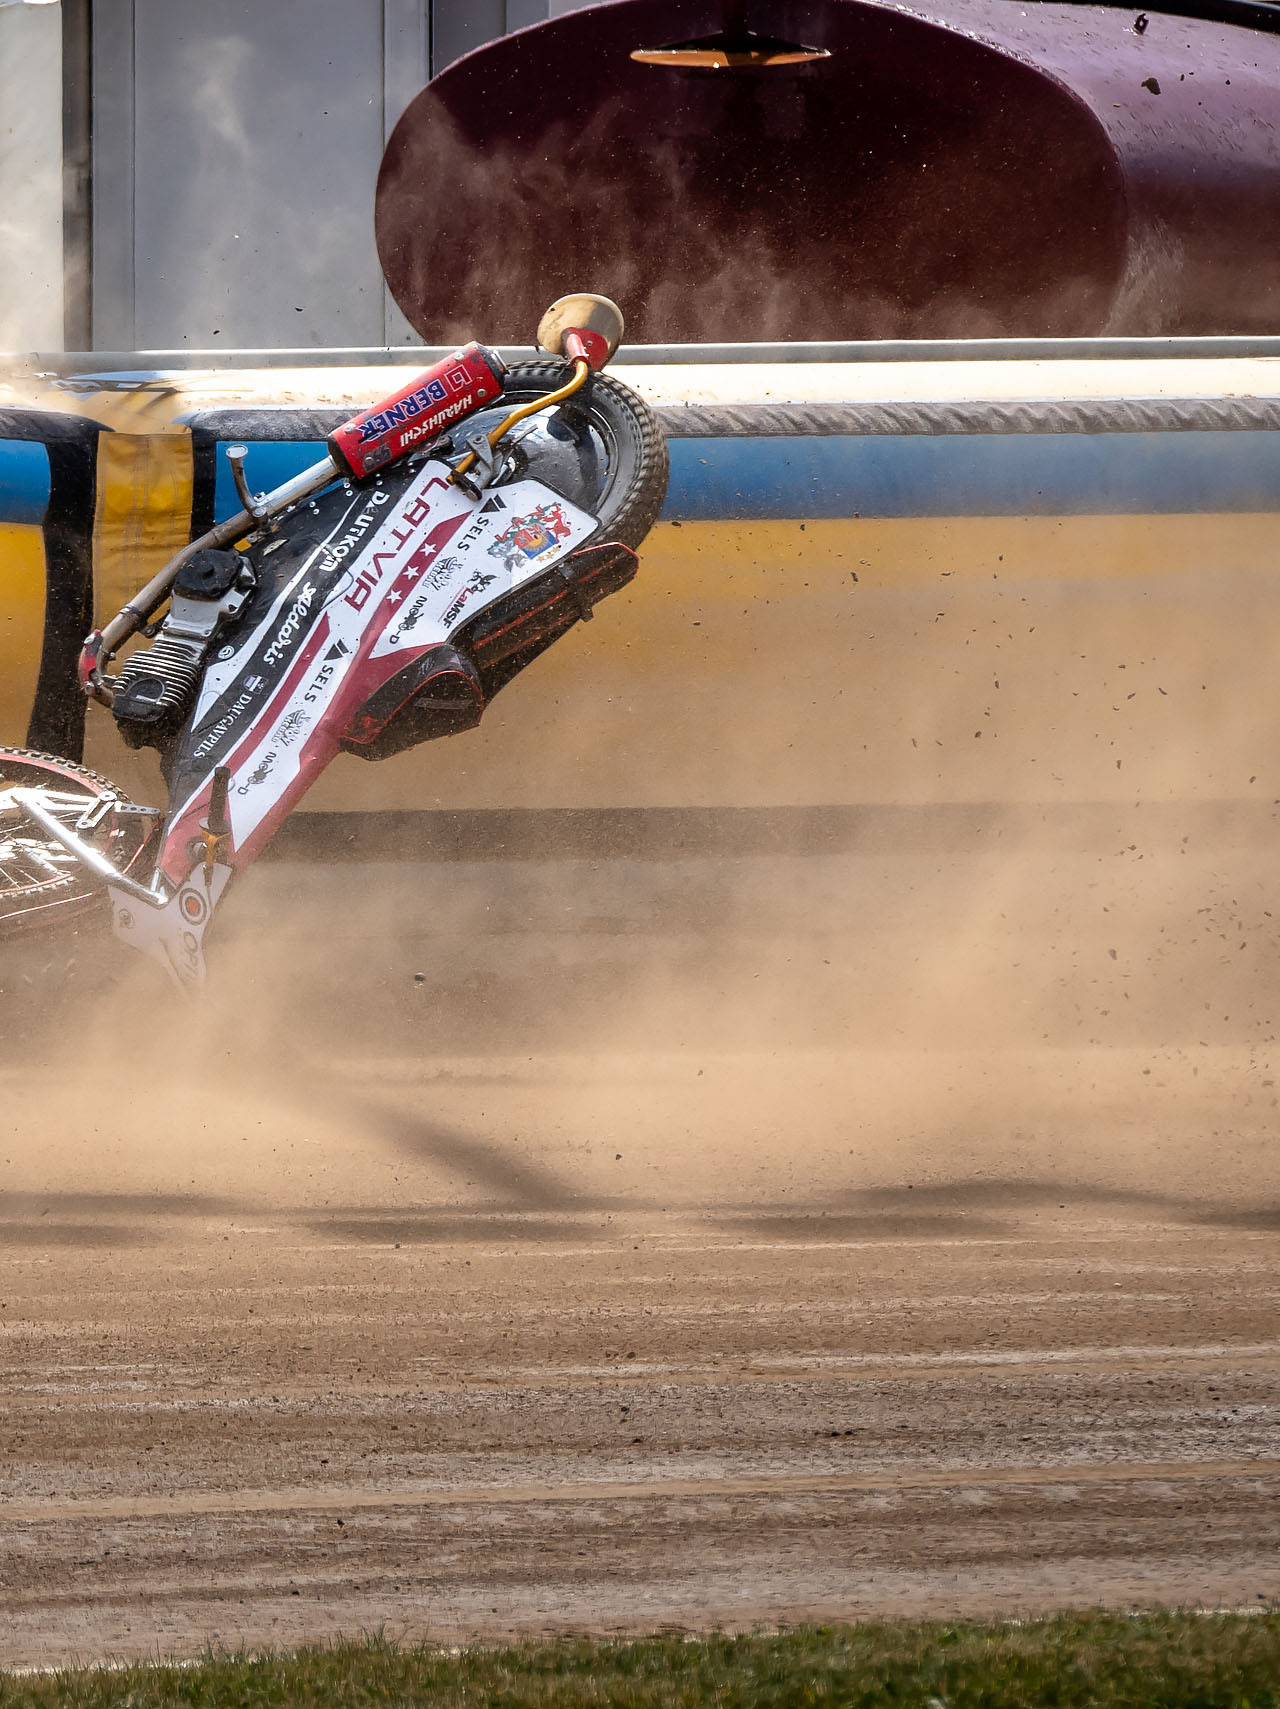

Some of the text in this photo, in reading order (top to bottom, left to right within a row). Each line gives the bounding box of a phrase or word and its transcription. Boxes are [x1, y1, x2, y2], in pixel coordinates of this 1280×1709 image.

[354, 378, 447, 442] BERNER
[344, 476, 450, 611] LATVIA
[456, 515, 489, 552] SELS
[440, 586, 474, 628] LaMSF
[303, 664, 333, 704] SELS
[192, 693, 251, 759] DAUGAVPILS
